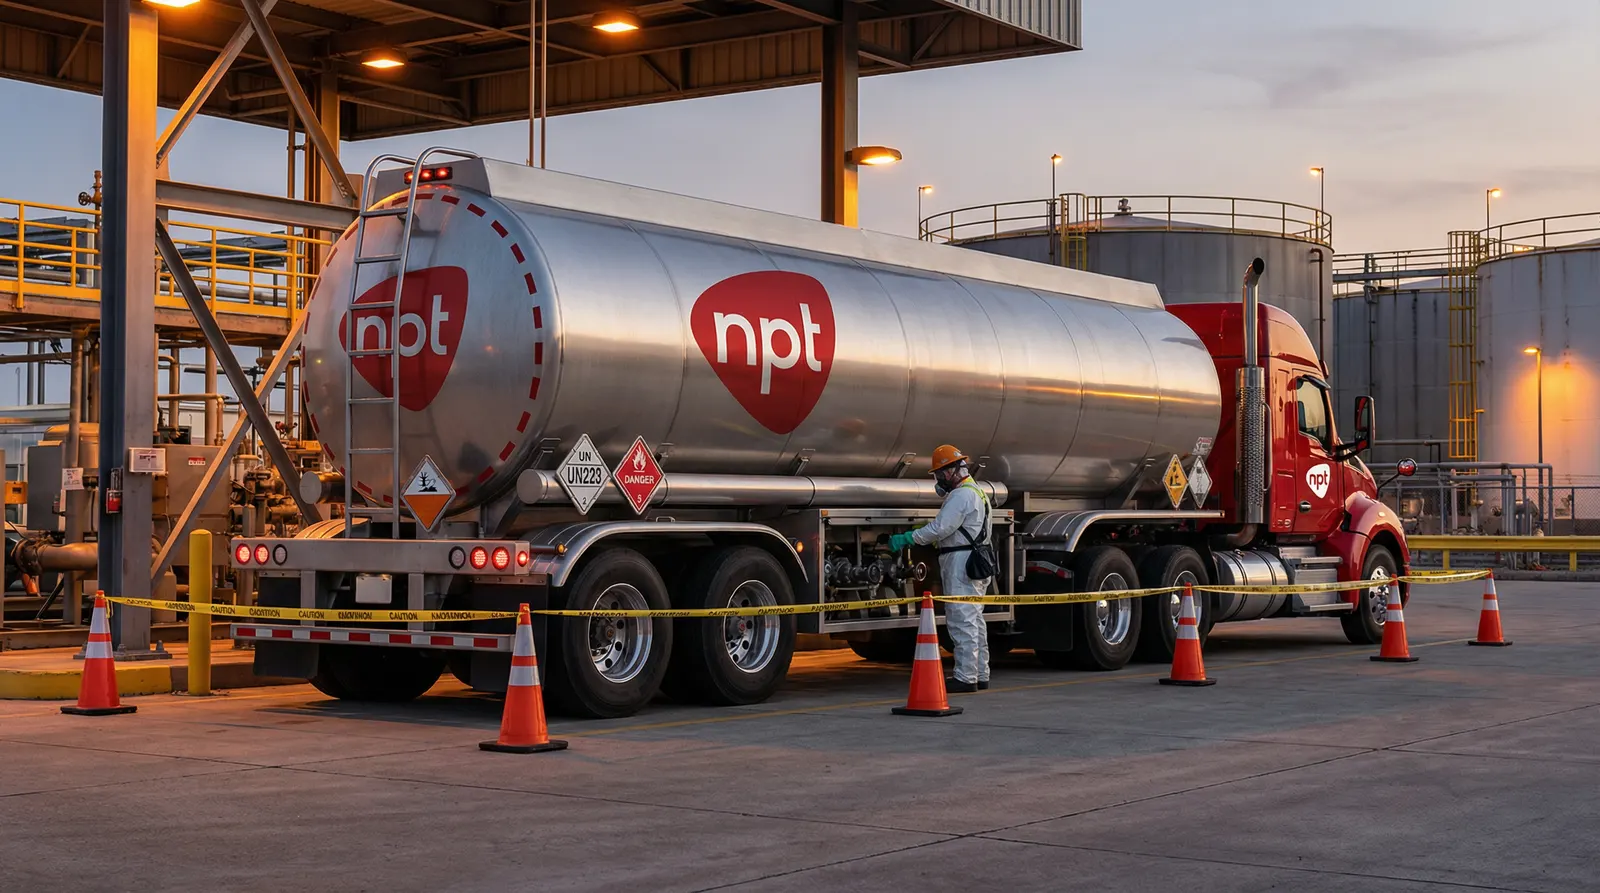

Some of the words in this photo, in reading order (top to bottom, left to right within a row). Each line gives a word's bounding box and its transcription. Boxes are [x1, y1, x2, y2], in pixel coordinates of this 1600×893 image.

[355, 294, 449, 379] npt
[713, 302, 822, 395] npt
[578, 451, 592, 462] UN
[567, 466, 602, 485] UN223
[624, 474, 655, 485] DANGER
[1309, 470, 1329, 490] npt
[582, 497, 587, 505] 2
[210, 605, 236, 615] CAUTION
[298, 610, 325, 619] CAUTION
[389, 611, 418, 620] CAUTION
